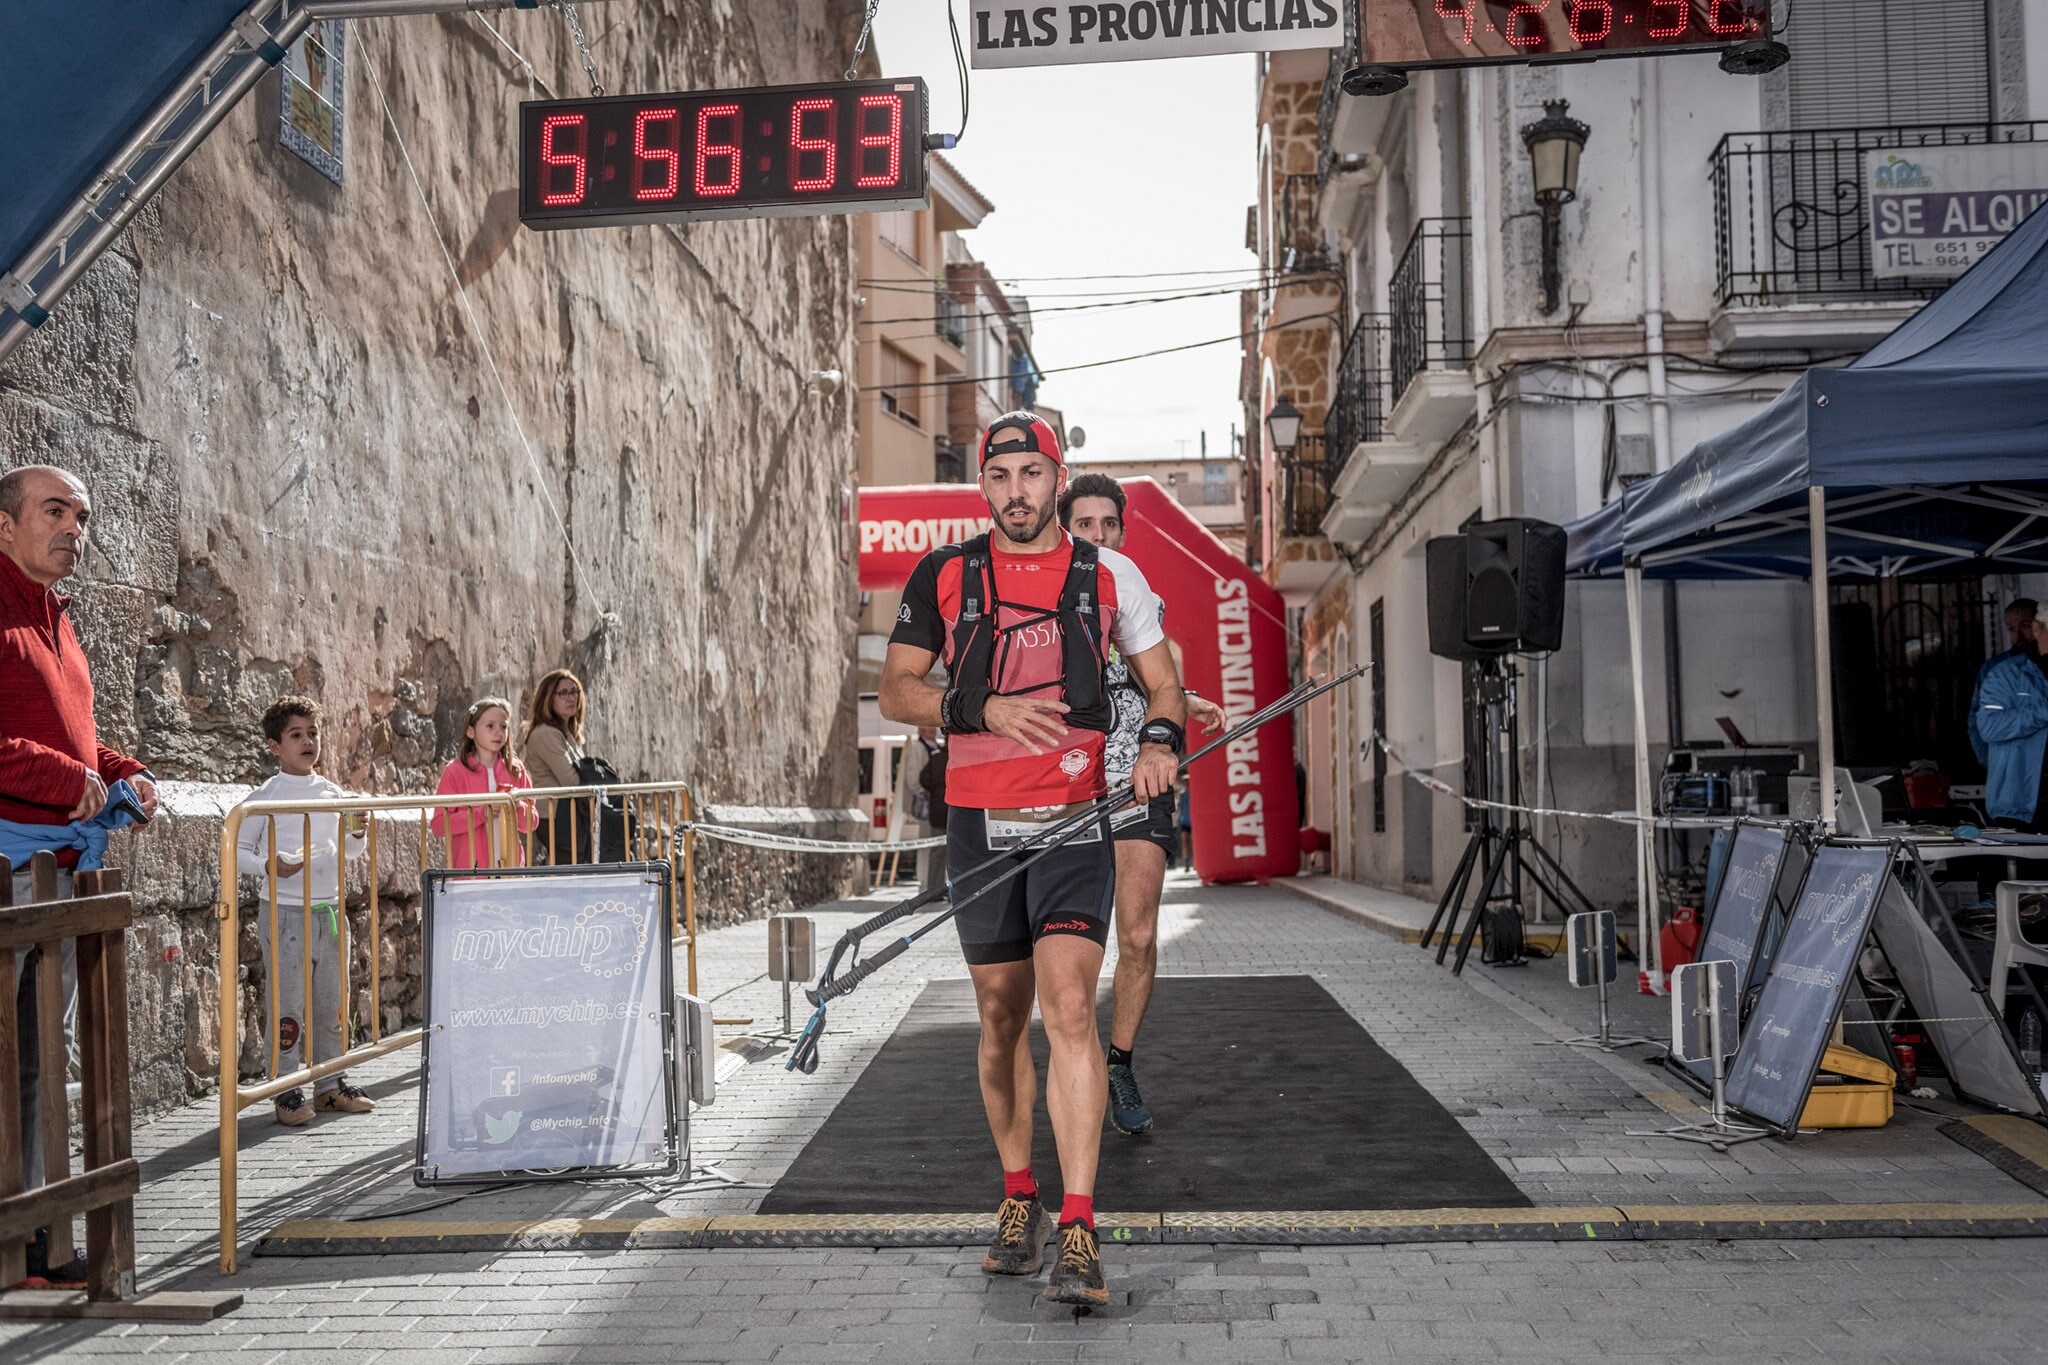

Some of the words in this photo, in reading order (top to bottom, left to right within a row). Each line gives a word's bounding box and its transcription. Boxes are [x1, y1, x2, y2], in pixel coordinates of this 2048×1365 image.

[976, 7, 1058, 50] LAS
[1068, 0, 1339, 44] PROVINCIAS
[1880, 197, 1926, 235] SE
[1935, 242, 1967, 253] 651
[1936, 256, 1970, 266] 964
[859, 516, 995, 553] PROVIN
[1214, 577, 1262, 787] PROVINCIAS
[1229, 790, 1267, 859] LAS
[453, 914, 613, 969] mychip
[450, 999, 643, 1029] www.mychip.es
[532, 1071, 598, 1087] /infomychip
[530, 1115, 611, 1133] @Mychip_Info
